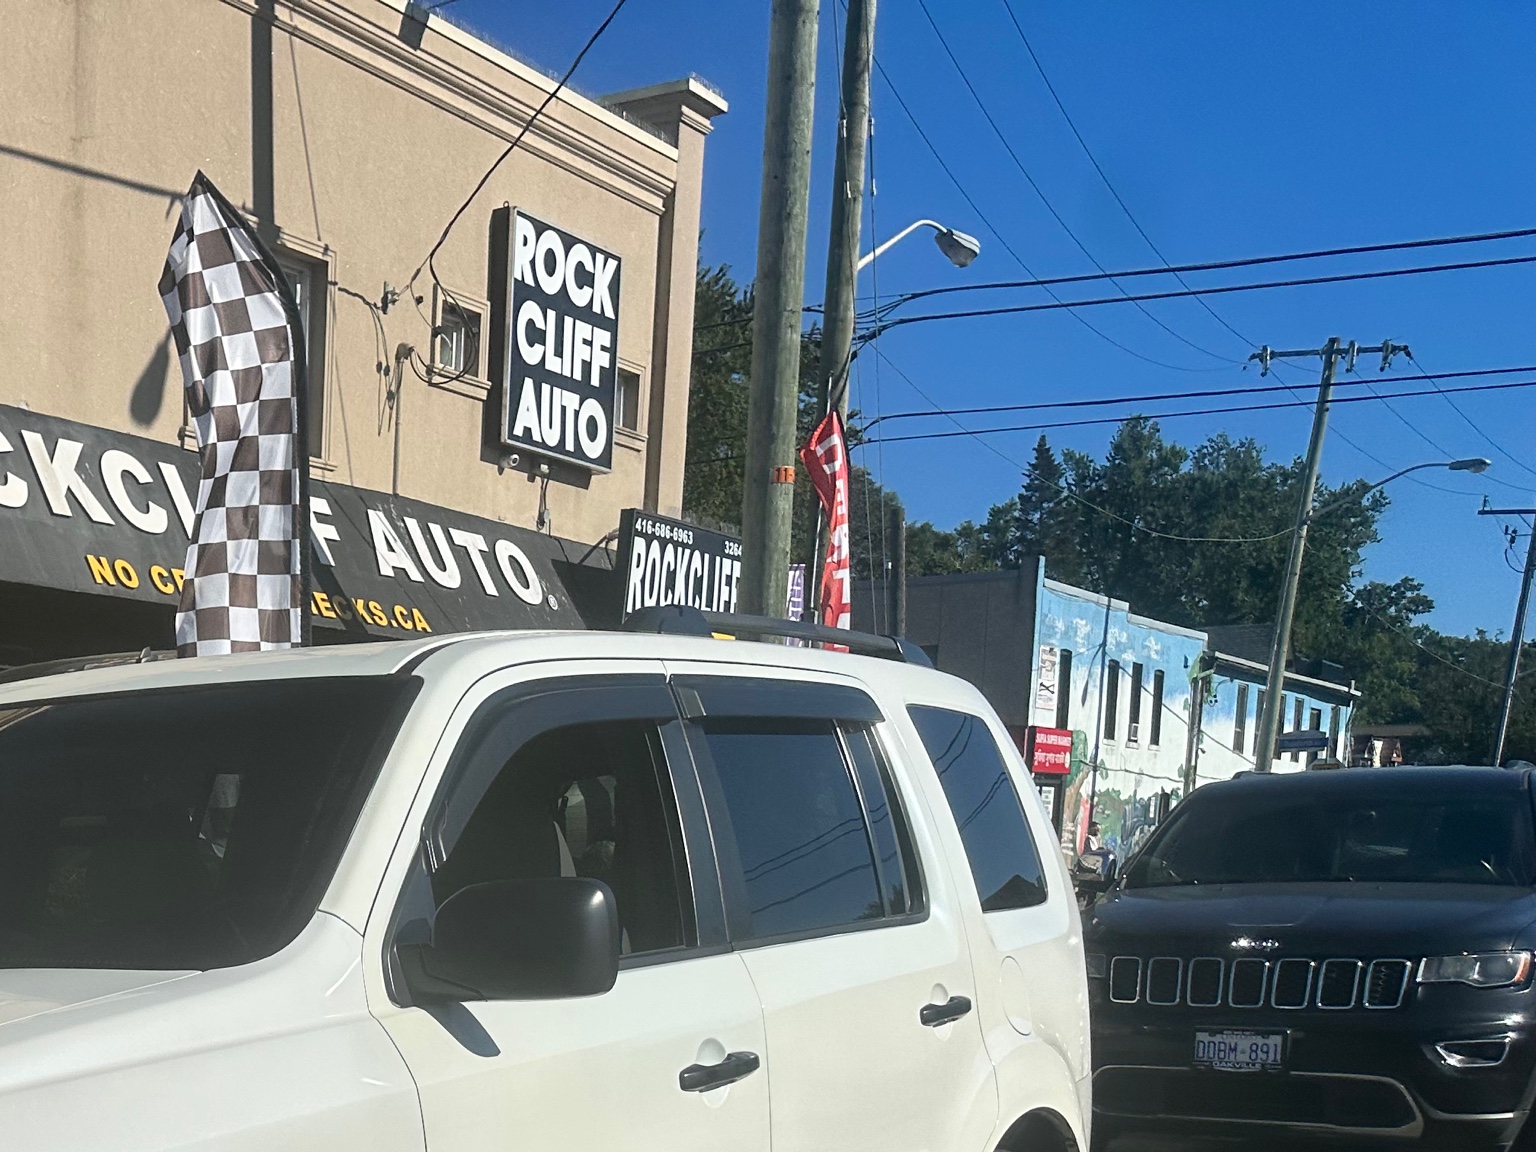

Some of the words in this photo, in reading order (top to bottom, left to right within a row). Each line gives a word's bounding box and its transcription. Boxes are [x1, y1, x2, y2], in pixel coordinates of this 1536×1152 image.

[514, 215, 618, 320] ROCK
[516, 299, 611, 388] CLIFF
[513, 376, 607, 460] AUTO
[635, 517, 693, 545] 416-686-6963
[86, 553, 140, 589] NO
[626, 535, 742, 614] ROCKCLIFF
[1212, 1061, 1262, 1069] OAKVILLE
[1249, 1042, 1279, 1063] 891
